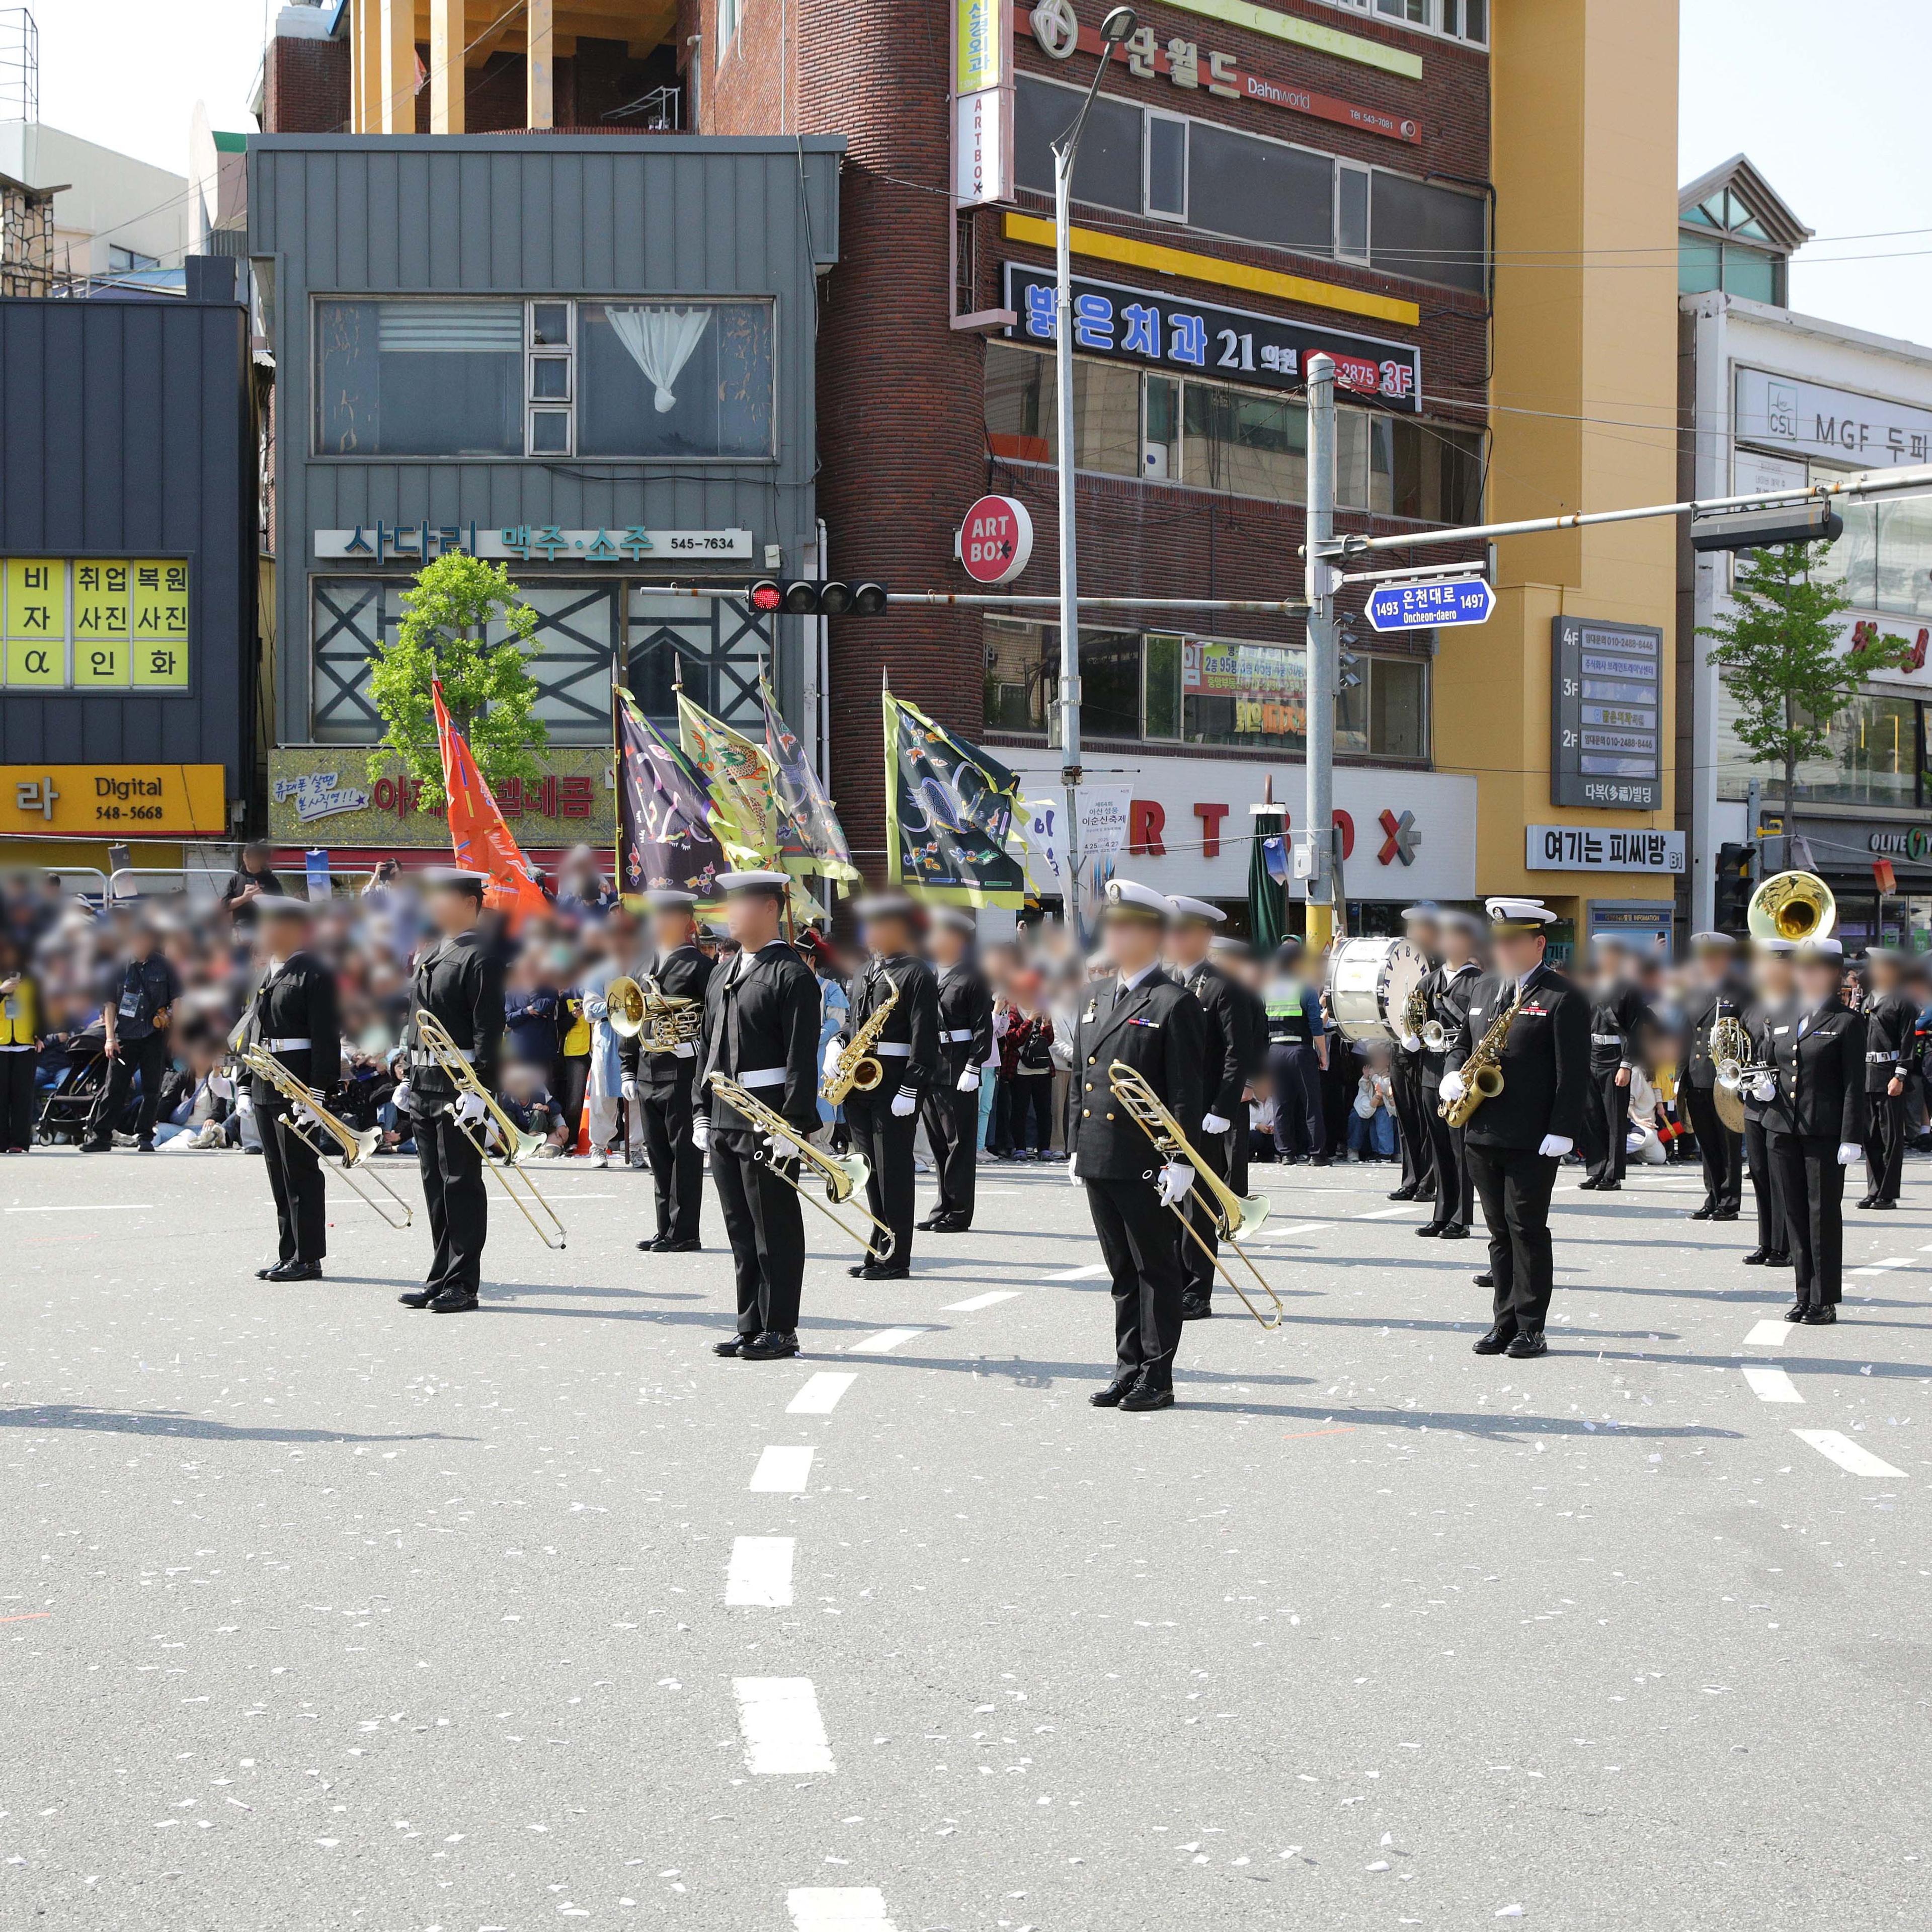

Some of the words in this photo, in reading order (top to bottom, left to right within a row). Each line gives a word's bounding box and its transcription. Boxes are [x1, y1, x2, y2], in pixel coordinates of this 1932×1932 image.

[1248, 77, 1310, 109] Dahnworld
[1217, 329, 1256, 372] 21
[1261, 345, 1298, 375] 의원
[1379, 360, 1413, 399] 3F
[1770, 413, 1795, 437] CSL
[1816, 413, 1869, 452] MGF
[1886, 428, 1927, 464] 두피
[972, 515, 1009, 538] ART
[344, 520, 476, 566] 사다리
[671, 537, 734, 550] 545-7634
[971, 539, 1012, 562] BOX
[1402, 587, 1456, 609] 온천대로
[1460, 594, 1484, 609] 1497
[1376, 602, 1399, 616] 1493
[1403, 609, 1457, 624] Oncheon-daero
[1563, 627, 1579, 646] 4F
[1585, 633, 1606, 646] 임대문의
[1563, 678, 1579, 696] 3F
[1563, 729, 1578, 748] 2F
[1585, 734, 1606, 746] 임대문의
[95, 777, 163, 800] Digital
[1585, 783, 1652, 803] 다복(多福)빌딩
[96, 806, 163, 820] 548-5668
[1545, 831, 1603, 863] 여기는
[1609, 833, 1666, 865] 피씨방
[1669, 852, 1683, 869] B1
[1870, 833, 1907, 852] OLIVE
